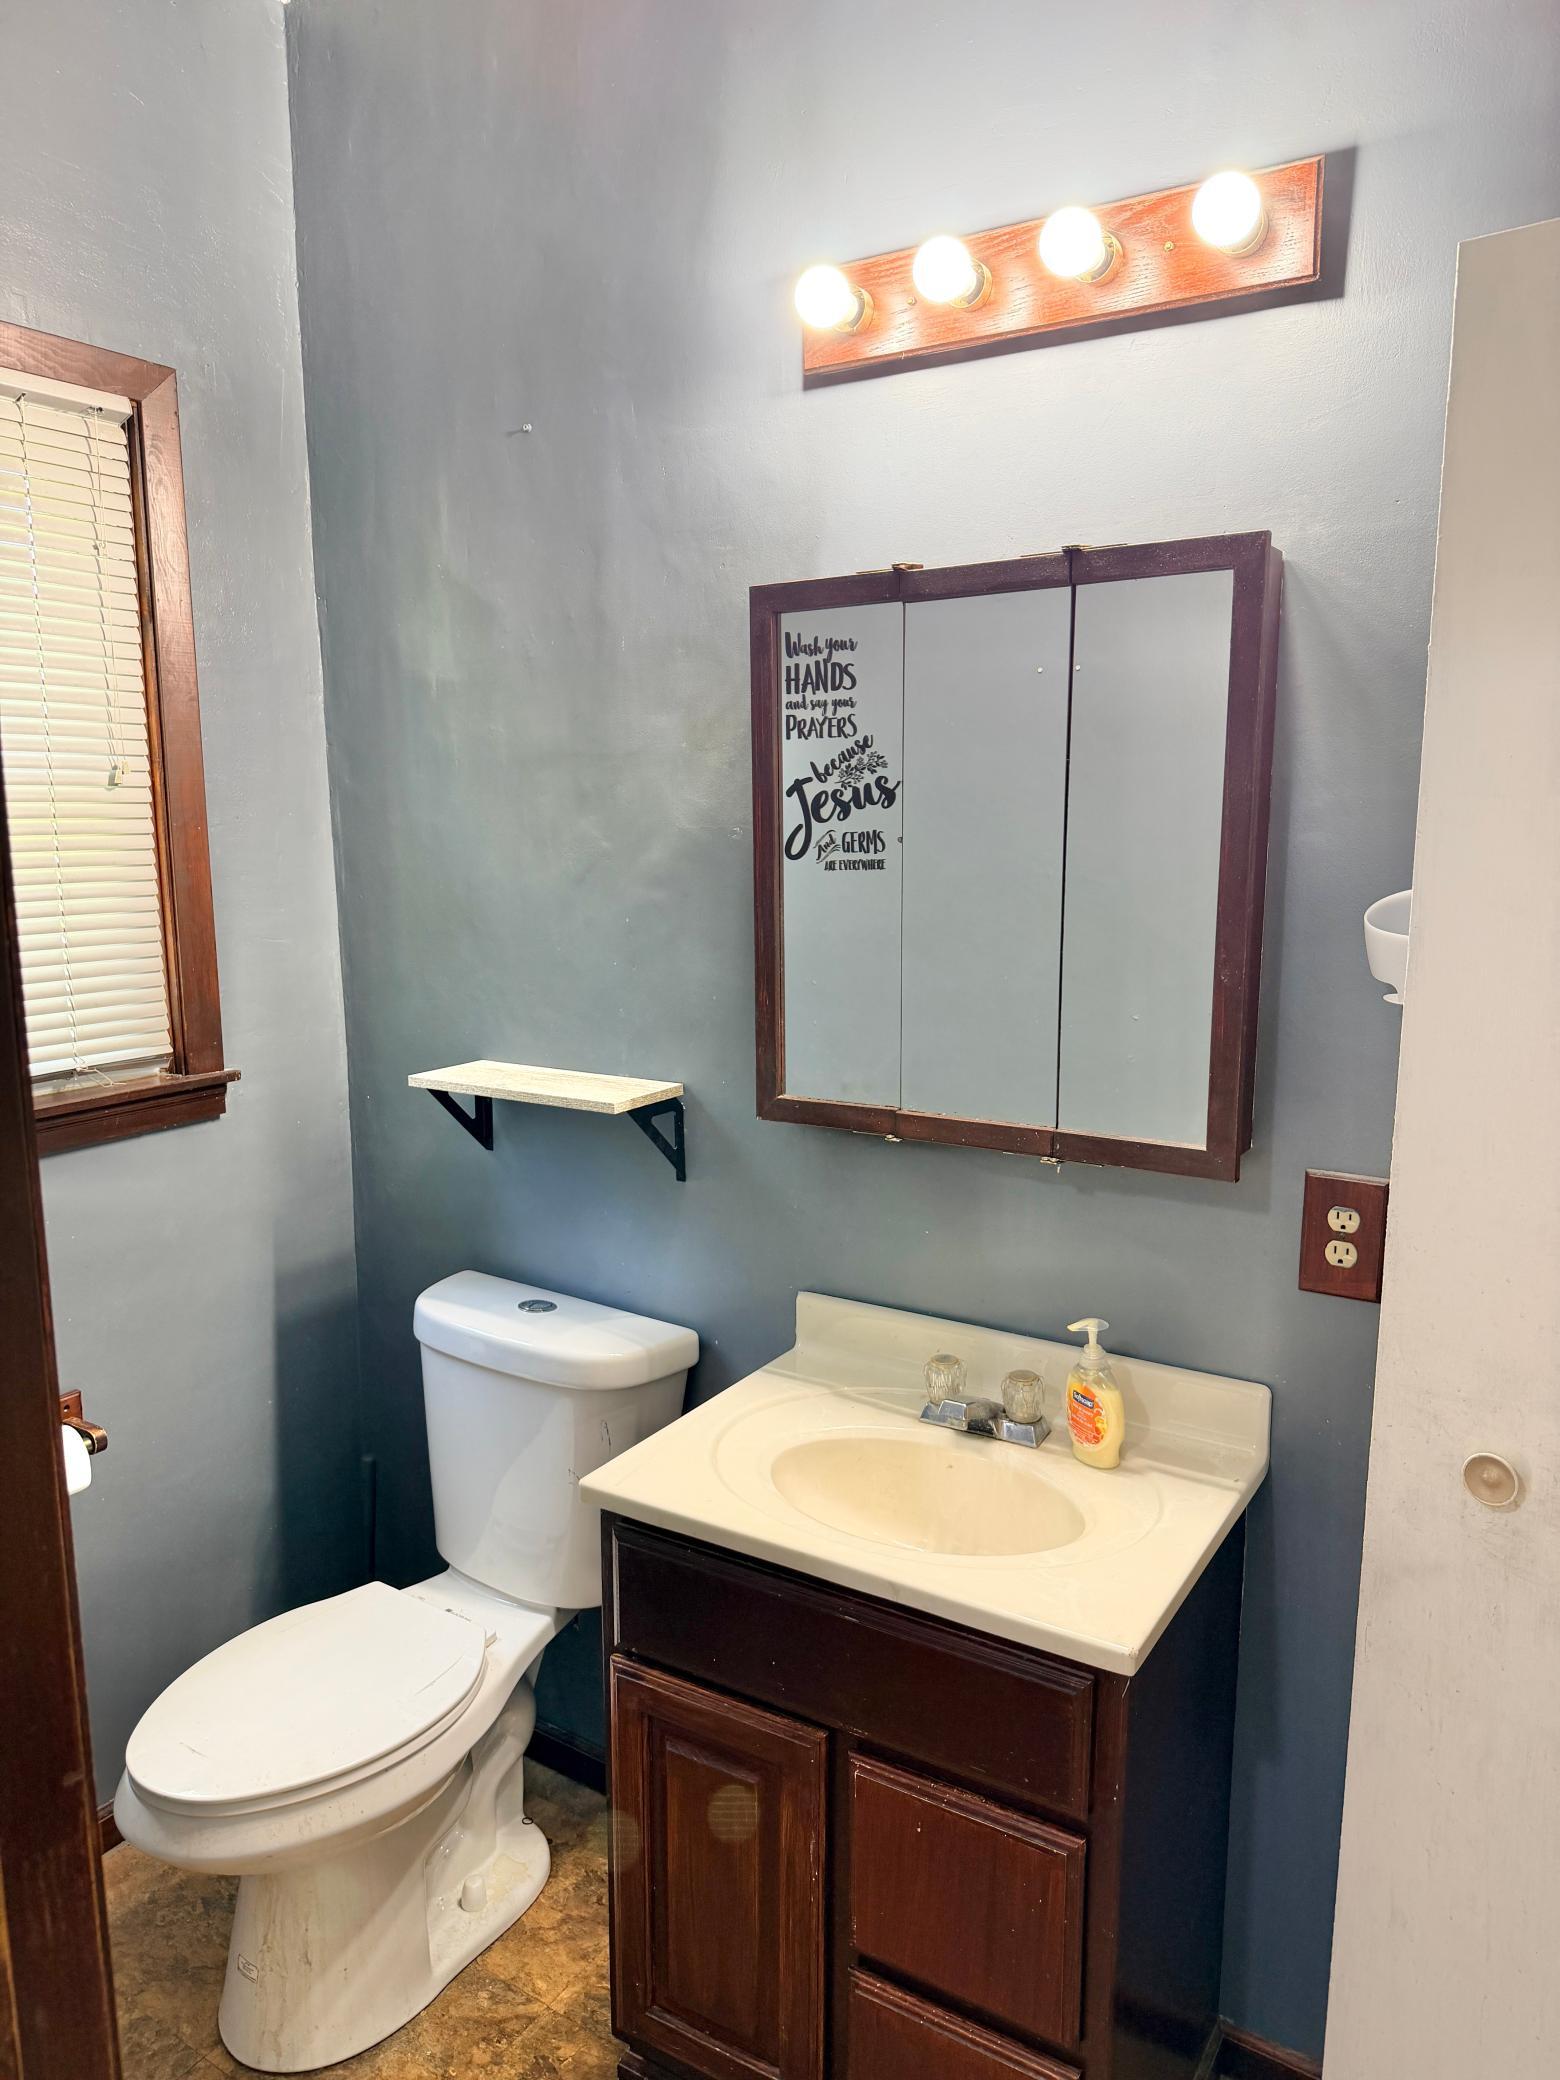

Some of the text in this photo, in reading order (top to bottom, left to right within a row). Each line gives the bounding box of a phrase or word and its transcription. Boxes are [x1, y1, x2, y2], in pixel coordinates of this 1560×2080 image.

[785, 632, 858, 662] Wash your
[785, 659, 857, 695] HANDS
[786, 694, 857, 716] and say your
[785, 713, 858, 740] PRAYERS
[810, 734, 874, 784] because
[784, 775, 902, 861] Jesus
[817, 830, 886, 855] And GERMS
[824, 858, 886, 871] ARE EVERYWHERE
